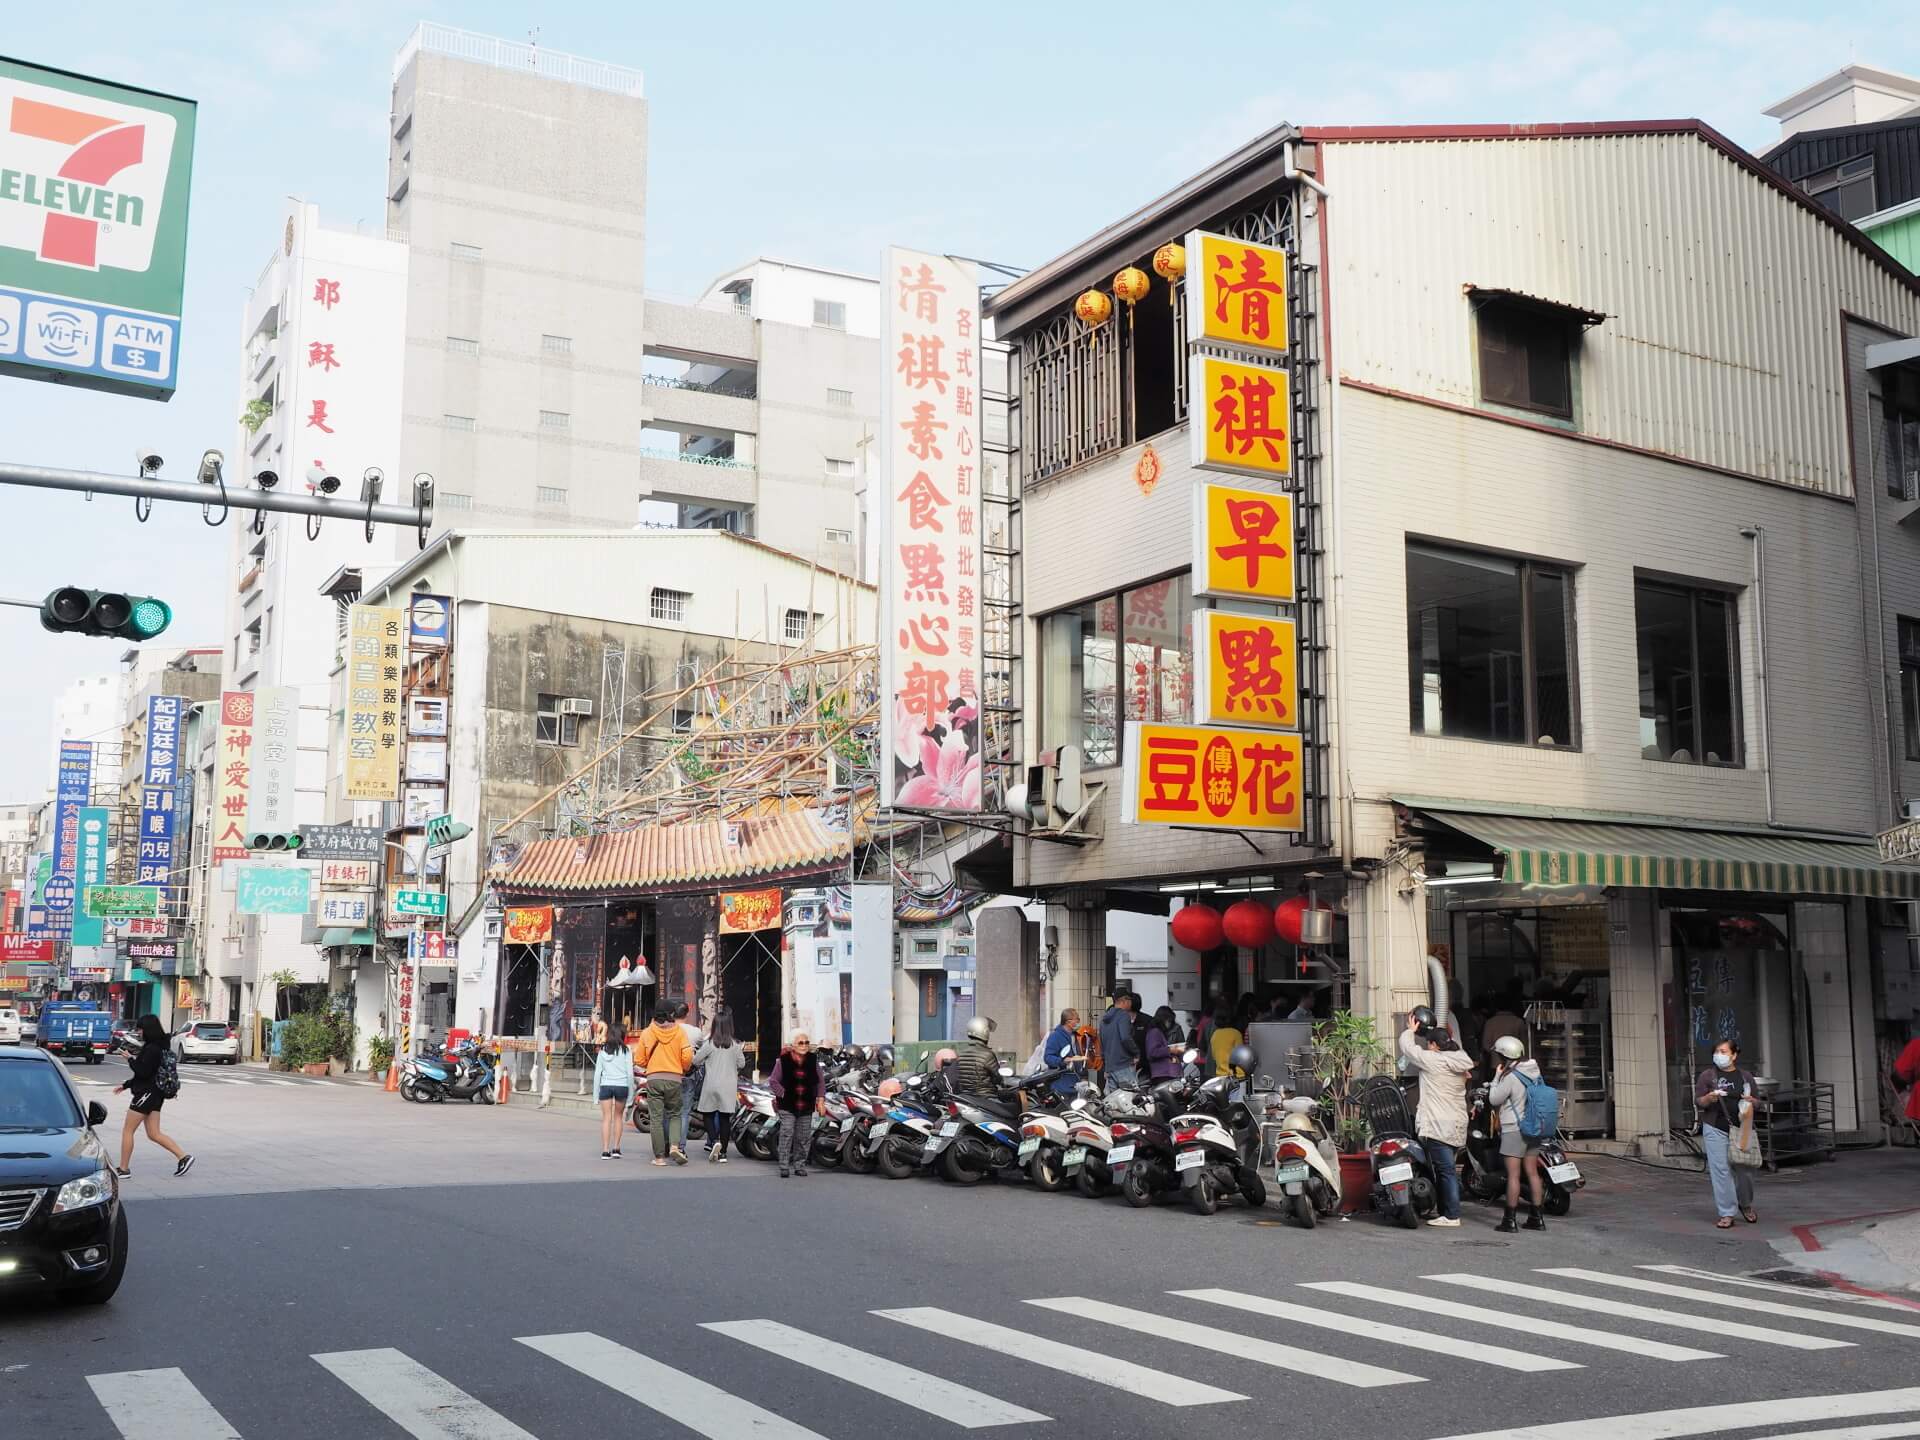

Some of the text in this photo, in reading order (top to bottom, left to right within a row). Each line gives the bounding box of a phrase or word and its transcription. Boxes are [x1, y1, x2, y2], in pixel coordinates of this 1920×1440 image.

[37, 322, 89, 347] Wi-Fi
[114, 322, 164, 345] ATM
[305, 278, 342, 492] 耶穌是
[897, 262, 951, 731] 清祺素食點心部
[956, 308, 975, 698] 各式點心訂做批發零售
[1213, 249, 1287, 718] 清祺早點
[382, 620, 399, 749] 各類樂器教學
[220, 728, 252, 842] 神愛世人
[1207, 746, 1233, 806] 傳統
[243, 880, 303, 901] Fiona
